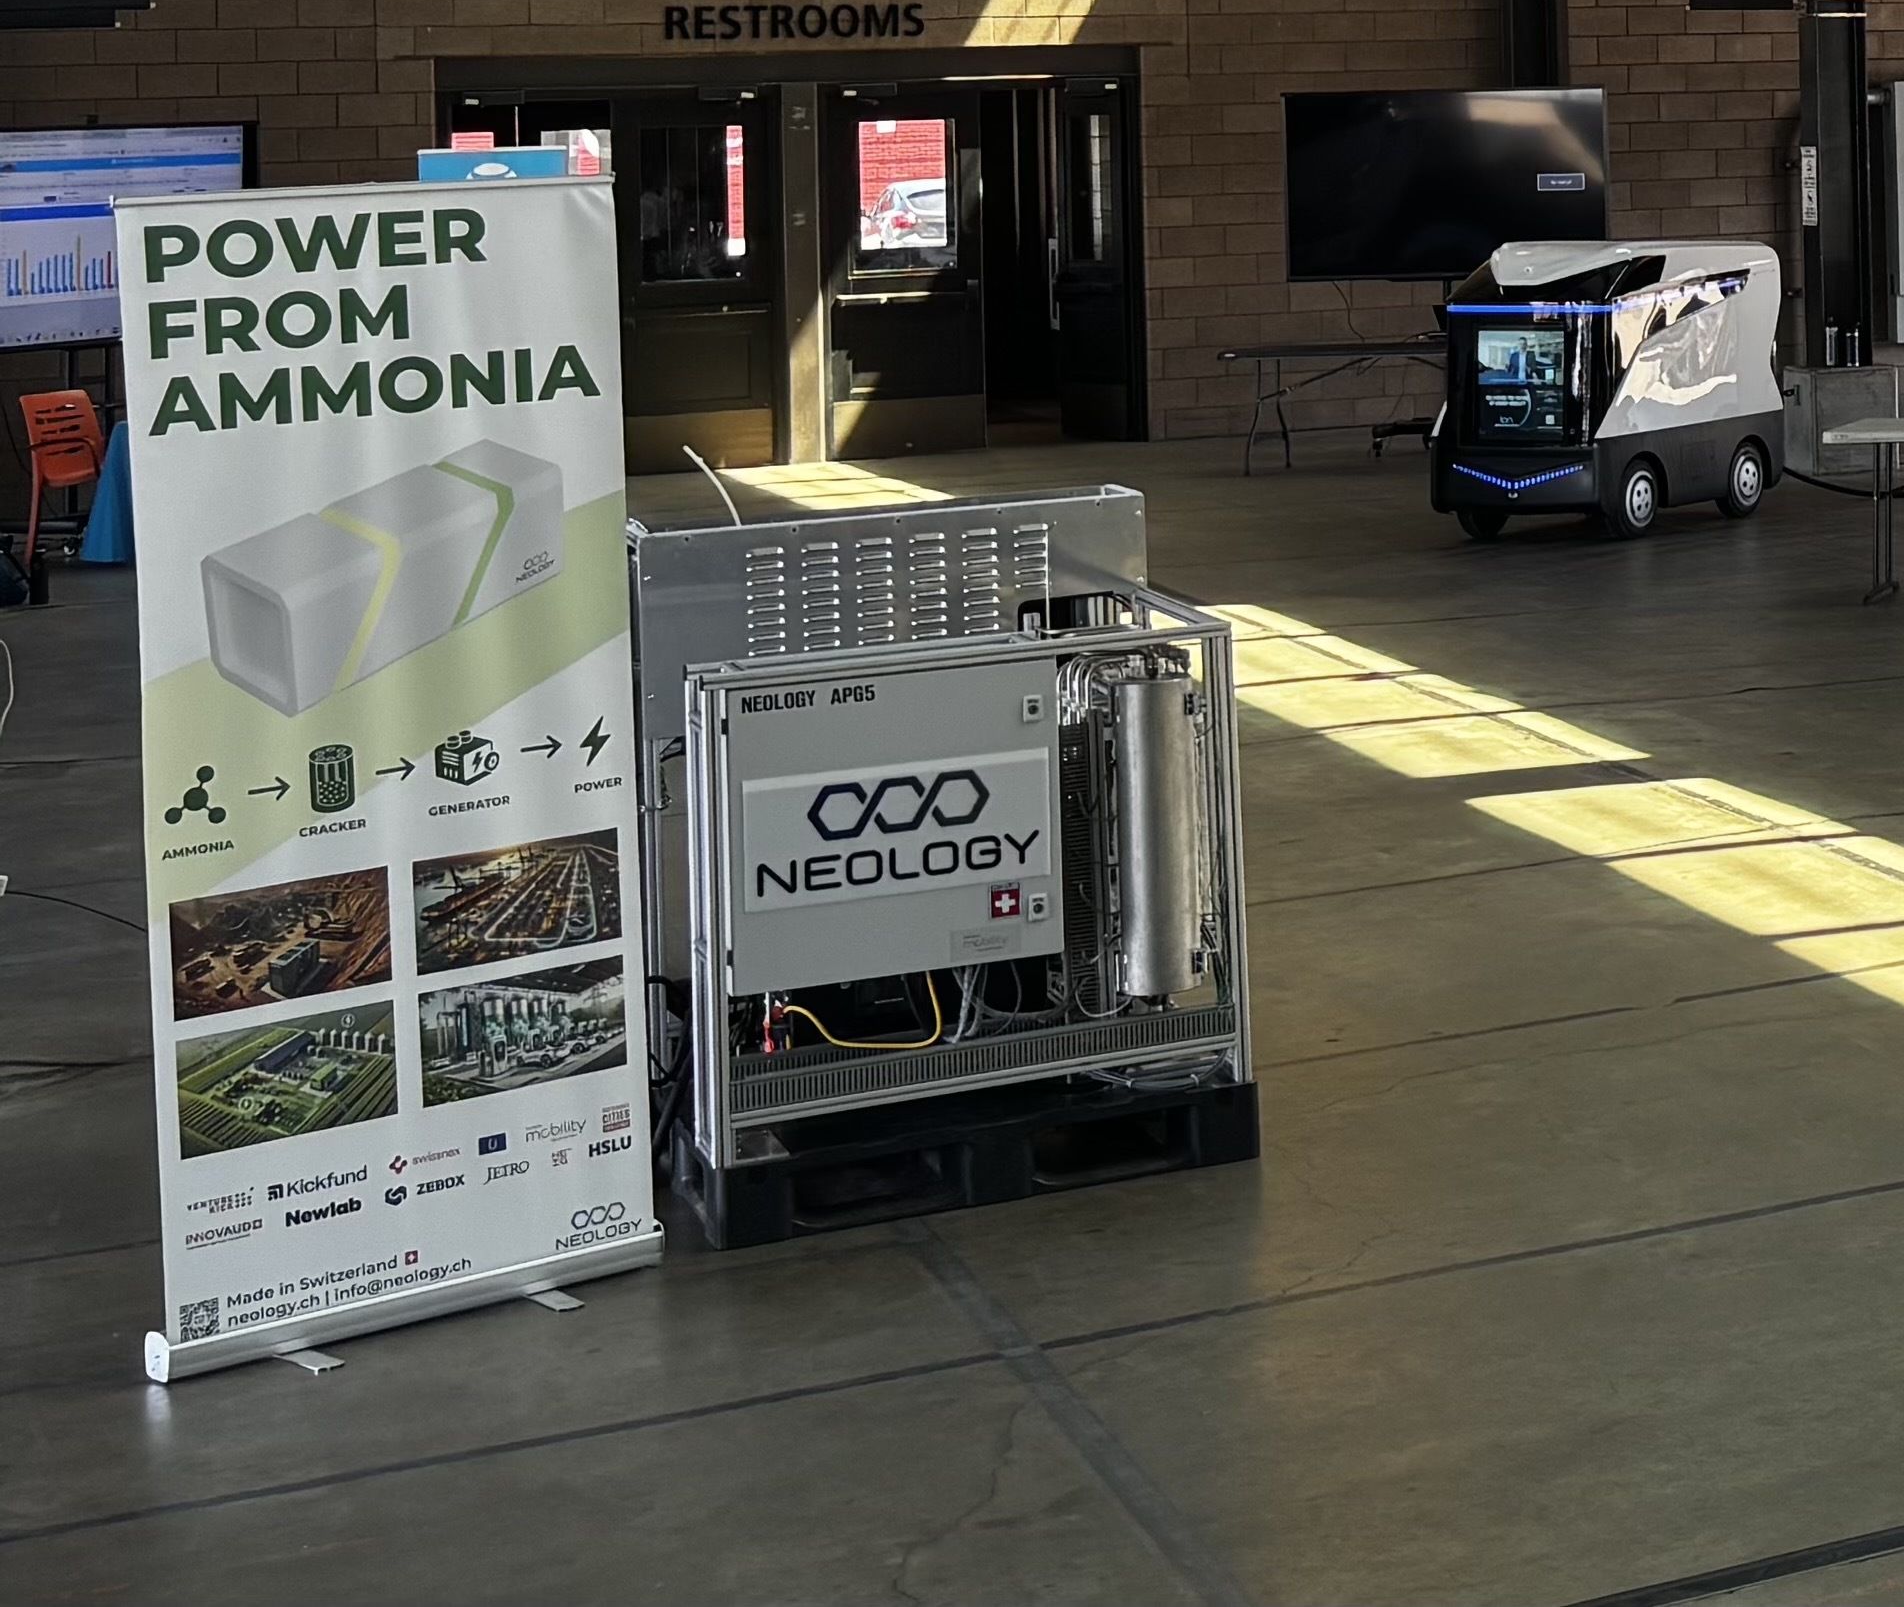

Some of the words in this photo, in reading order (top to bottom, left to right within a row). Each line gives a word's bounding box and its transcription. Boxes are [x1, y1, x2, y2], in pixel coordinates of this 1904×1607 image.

[664, 3, 925, 39] RESTROOMS
[143, 207, 488, 284] POWER
[147, 284, 411, 360] FROM
[148, 344, 601, 436] AMMONIA
[741, 690, 815, 714] NEOLOGY
[830, 684, 876, 705] APG5
[573, 776, 623, 794] POWER
[428, 795, 510, 817] GENERATOR
[299, 818, 367, 838] CRACKER
[161, 839, 235, 861] AMMONIA
[756, 829, 1039, 898] NEOLOGY
[526, 1119, 586, 1142] mobility
[588, 1135, 632, 1158] HSLU
[286, 1164, 368, 1197] Kickfund
[484, 1160, 530, 1185] JETRO
[285, 1198, 362, 1227] Newlab
[556, 1218, 642, 1251] NEOLOGY
[227, 1287, 275, 1308] Made
[279, 1282, 295, 1296] in
[300, 1255, 398, 1290] Switzerland
[228, 1291, 321, 1328] neology.ch
[334, 1257, 472, 1301] info@neology.ch
